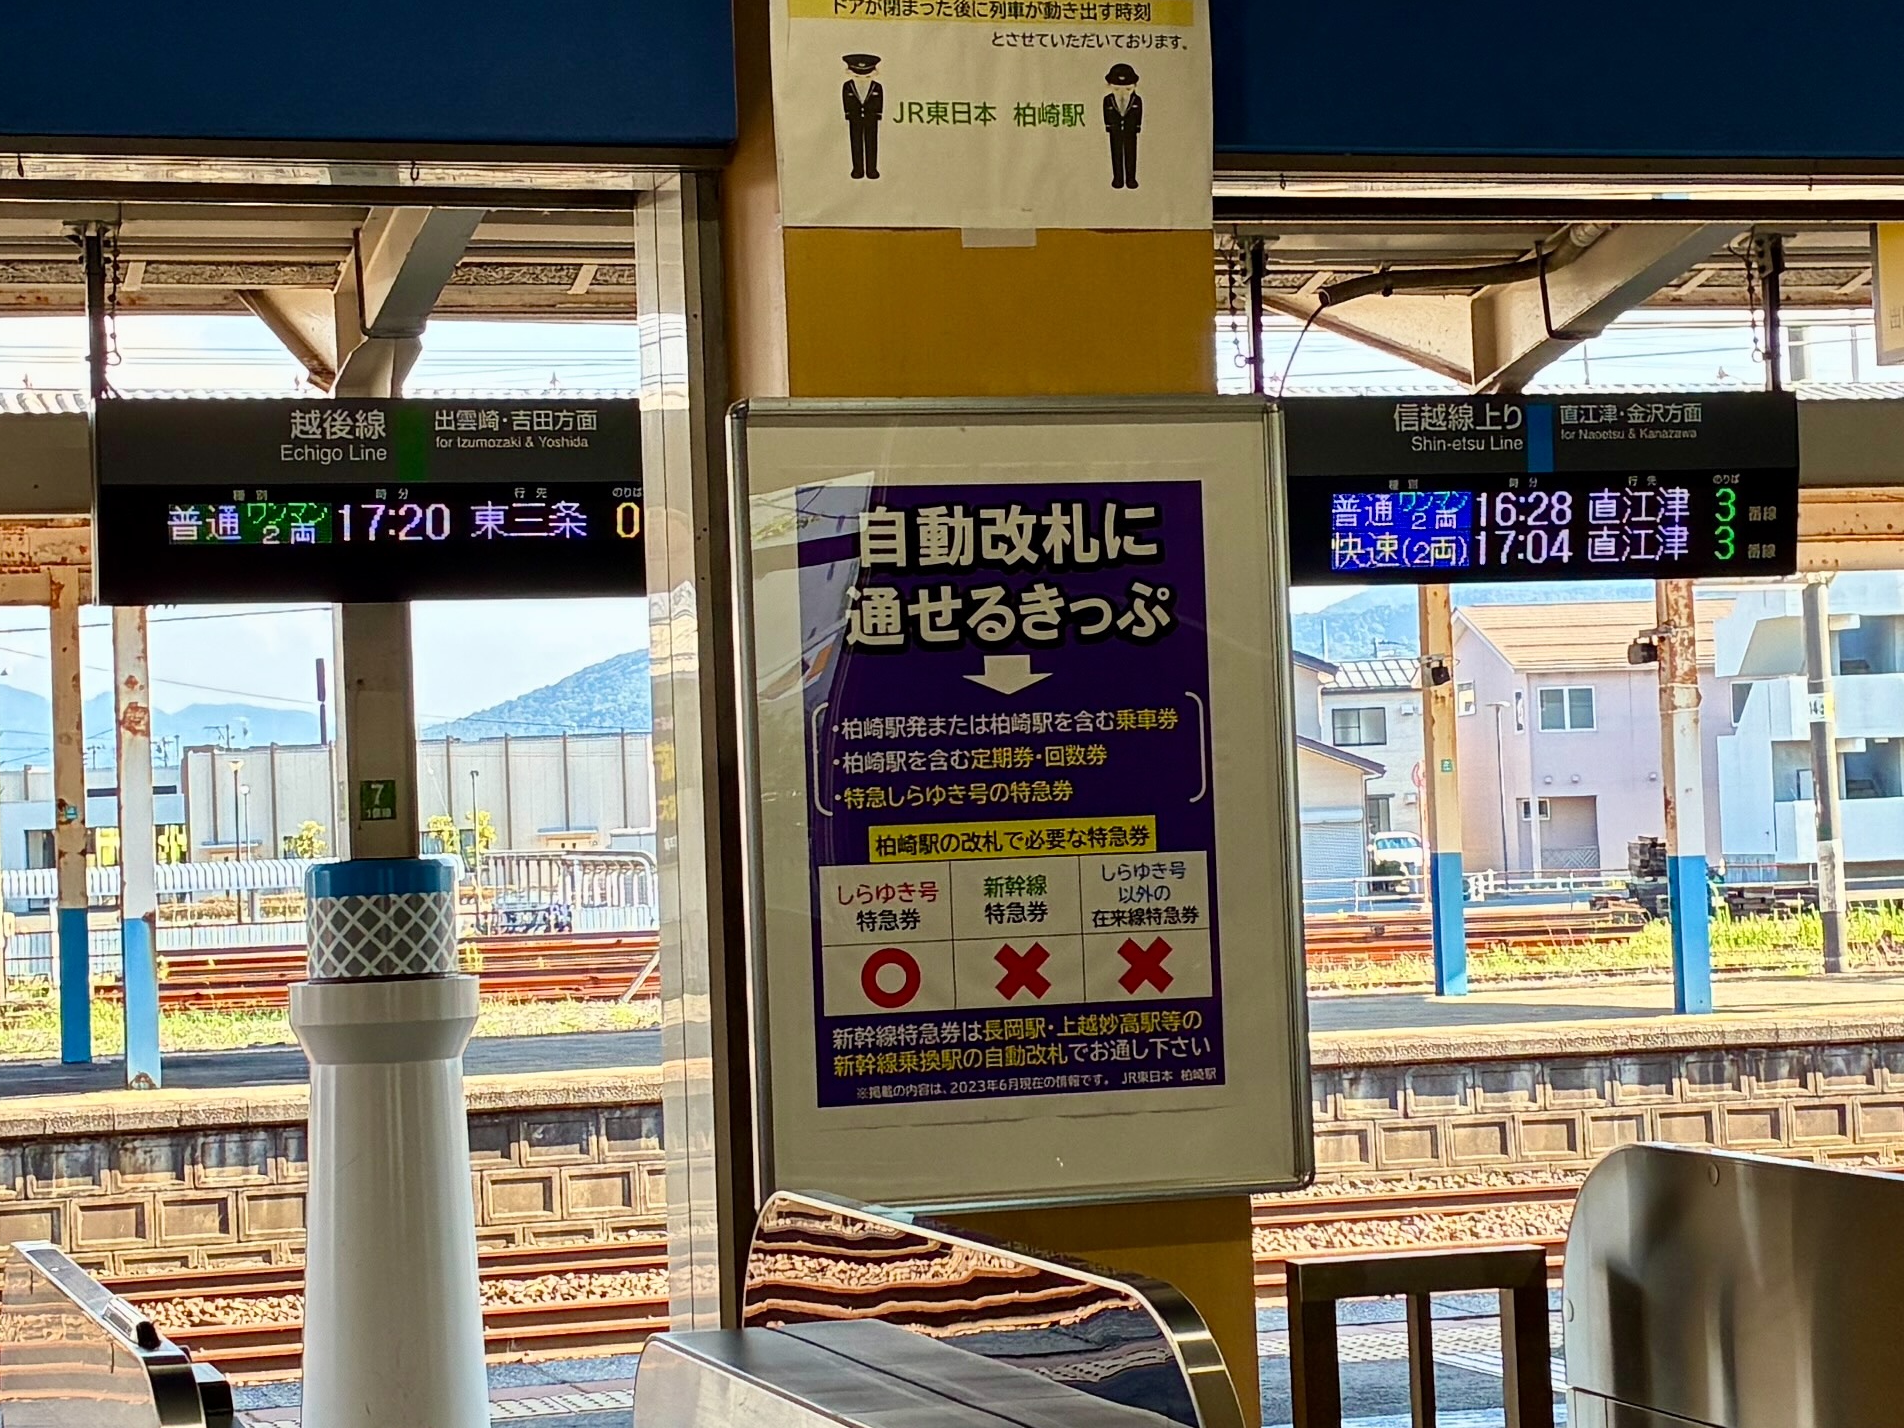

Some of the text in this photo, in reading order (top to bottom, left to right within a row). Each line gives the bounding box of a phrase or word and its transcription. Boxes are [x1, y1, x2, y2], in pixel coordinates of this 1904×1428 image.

[991, 31, 1189, 51] とさせていただいております。
[892, 101, 1086, 128] JR東日本 柏崎駅
[290, 409, 387, 440] 越後線
[434, 409, 598, 432] 出雲崎・吉田方面
[1393, 403, 1523, 433] 信越線上り
[1560, 403, 1702, 425] 直江津・金沢方面
[435, 436, 590, 449] for Izumozaki & Yoshida
[1411, 434, 1524, 452] Shin-etsu Line
[280, 443, 387, 469] Echigo Line
[1332, 493, 1395, 530] 普通
[1476, 491, 1573, 527] 16:28
[1588, 487, 1690, 527] 直江津
[1714, 487, 1738, 522] 3
[167, 503, 243, 544] 普通
[261, 523, 317, 545] 2両
[338, 501, 640, 542] 17:20 東三条 0
[858, 503, 1158, 568] 自動改札に
[1476, 530, 1573, 565] 17:04
[1588, 525, 1690, 563] 直江津
[1714, 526, 1737, 559] 3
[846, 583, 1173, 647] 通せるきっぷ
[371, 784, 384, 805] 7
[875, 824, 1151, 857] 柏崎駅の改札で必要な特急券
[1101, 860, 1187, 882] しらゆき号
[838, 881, 939, 905] しらゆき号
[983, 874, 1048, 899] 新幹線
[1118, 883, 1171, 904] 以外の
[856, 908, 921, 933] 特急券
[984, 900, 1049, 925] 特急券
[1091, 905, 1200, 930] 在来線特急券
[832, 1010, 1203, 1051] 新幹線特急券は長岡駅・上越妙高駅等の
[833, 1035, 1212, 1078] 新幹線乗換駅の自動改札でお通し下さい
[1120, 1070, 1174, 1085] JR東日本
